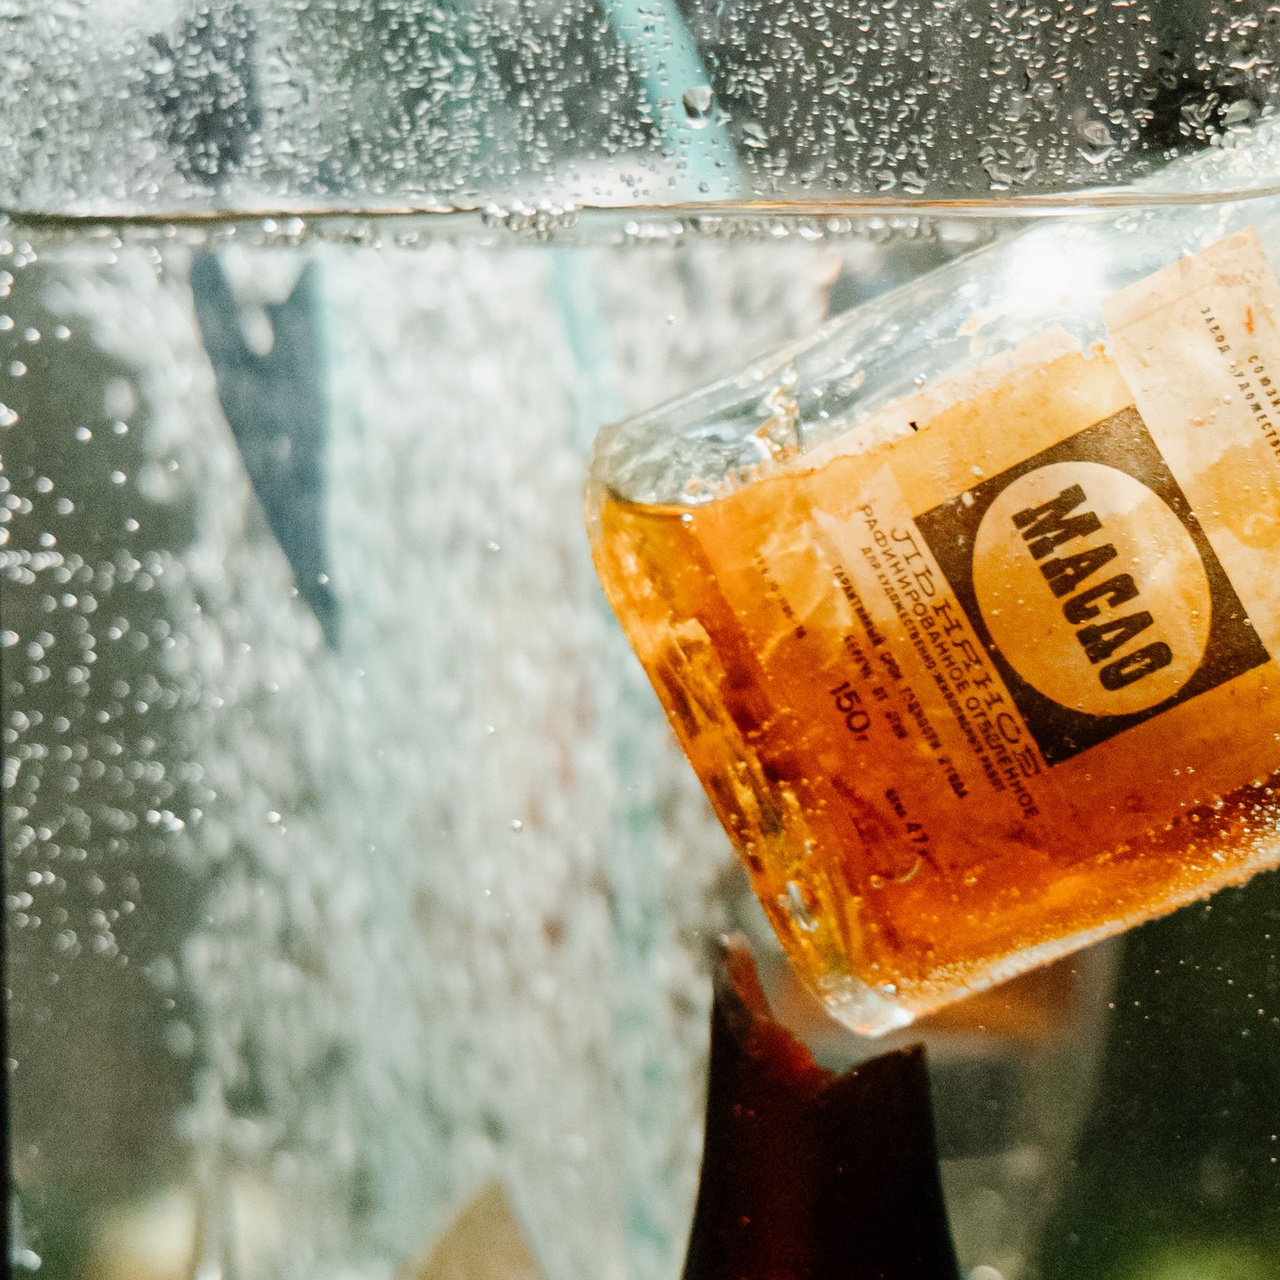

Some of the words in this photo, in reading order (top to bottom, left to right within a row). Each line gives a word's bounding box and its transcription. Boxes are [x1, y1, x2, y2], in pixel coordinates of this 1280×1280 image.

[1197, 306, 1232, 355] ЗАВОД
[857, 502, 970, 695] РАФИНИРОВАННОЕ
[963, 694, 1039, 819] ОТБЕЛЕННОЕ
[860, 544, 882, 571] ДЛЯ
[888, 521, 1041, 782] ЛЬНЯНОЕ
[1011, 480, 1176, 697] МАСЛО
